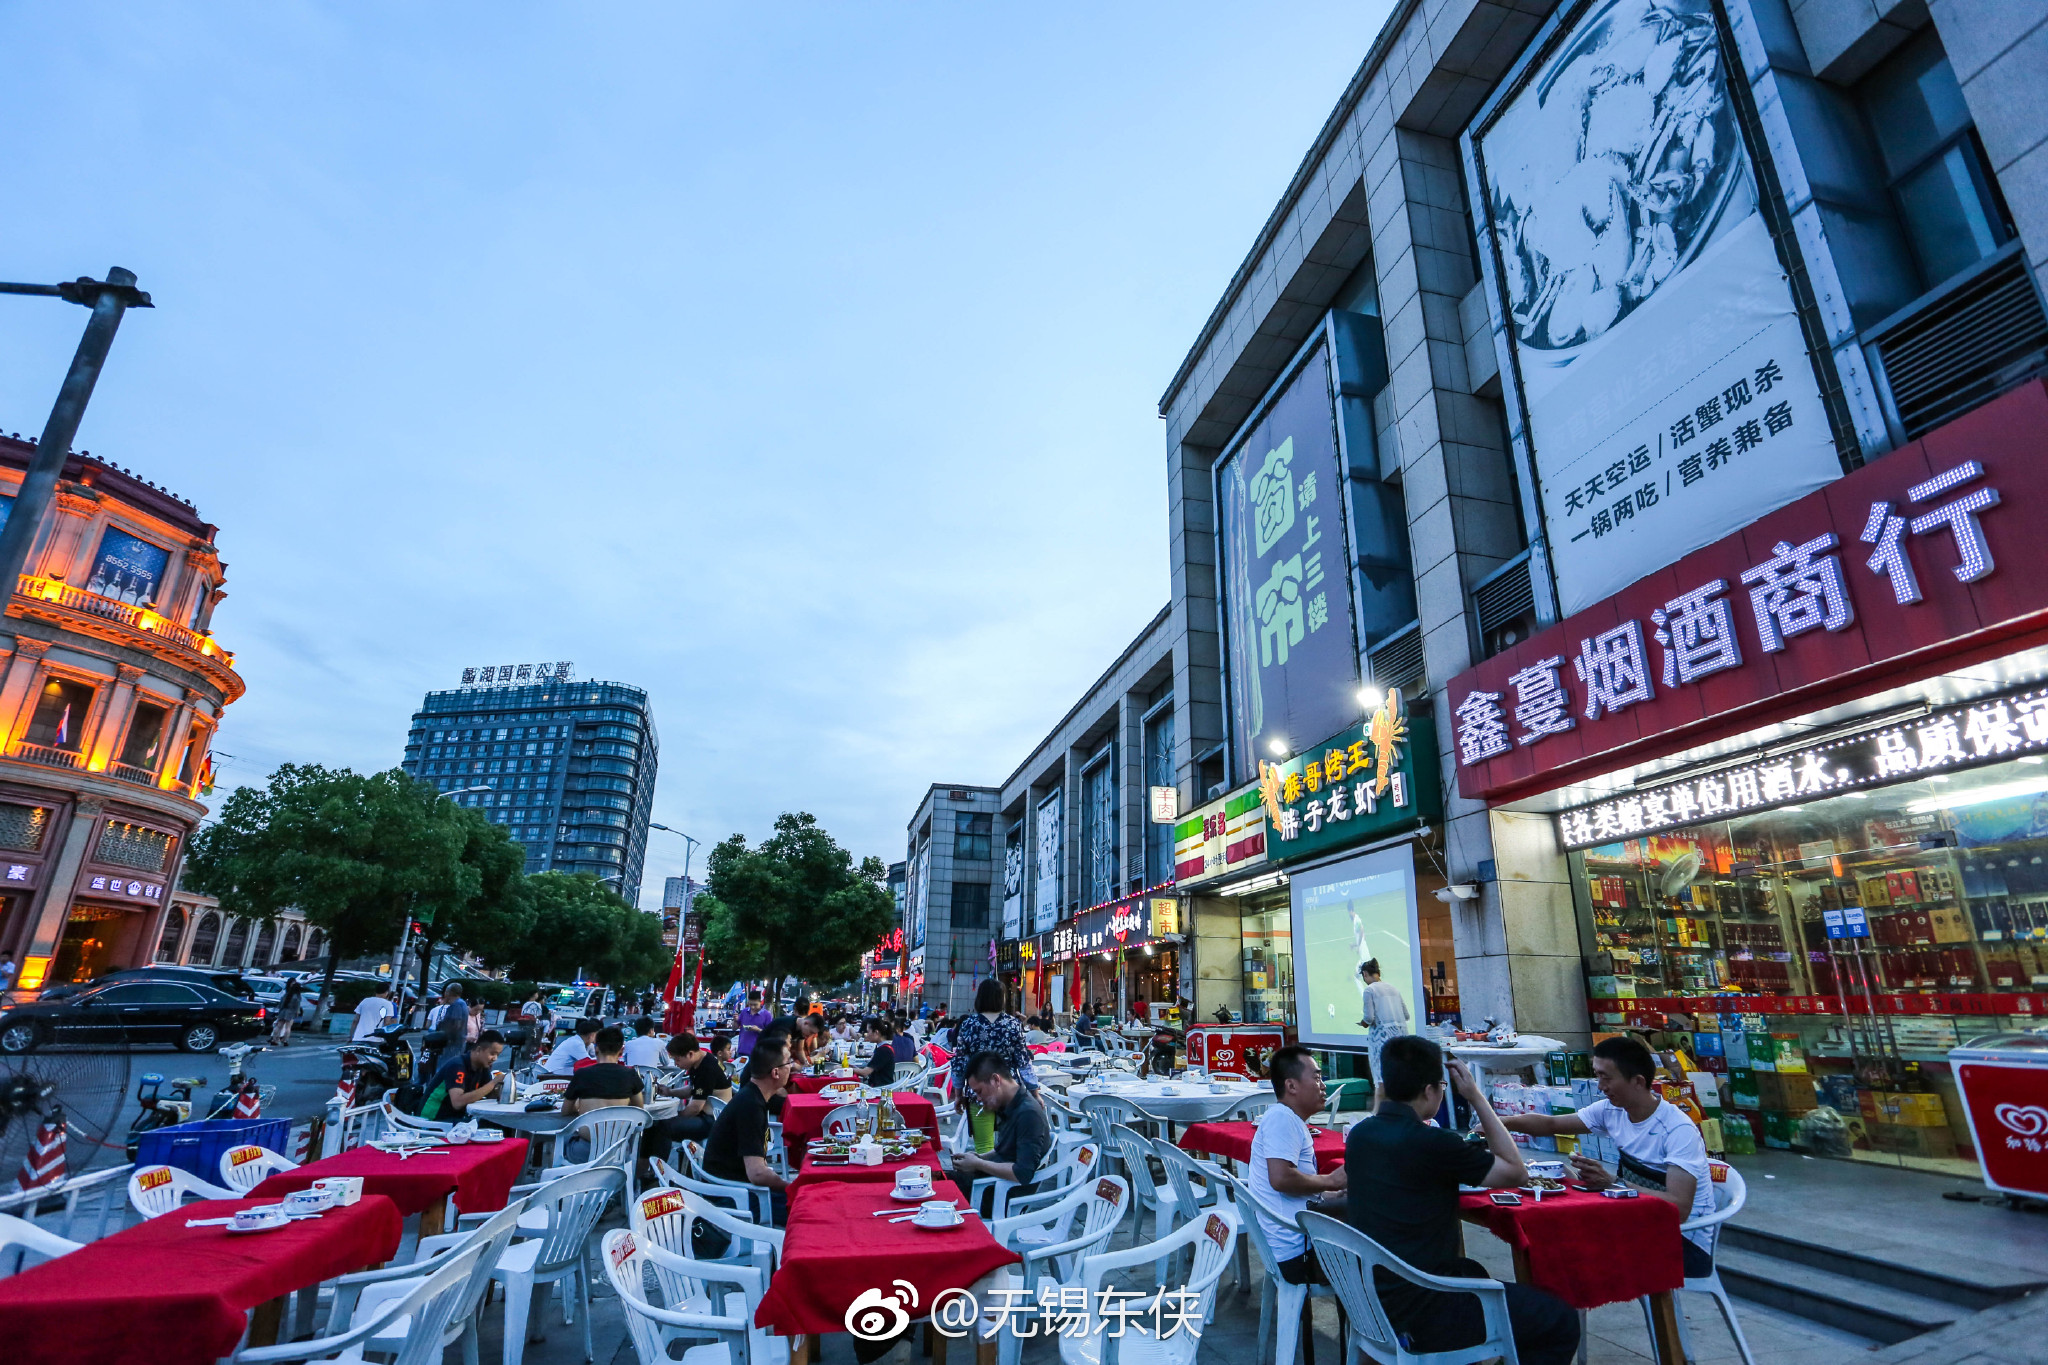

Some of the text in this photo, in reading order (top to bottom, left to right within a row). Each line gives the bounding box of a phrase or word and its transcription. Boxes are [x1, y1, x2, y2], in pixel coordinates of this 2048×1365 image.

[105, 554, 153, 580] 8552 5555
[1251, 435, 1304, 668] 窗帘
[1298, 470, 1329, 634] 请上三楼
[1455, 459, 2000, 766] 鑫蔓烟酒商行
[1283, 740, 1369, 804] 猴哥烤王
[1281, 778, 1377, 842] 胖子龙虾
[91, 876, 122, 892] 盛世
[1158, 901, 1173, 933] 超市
[455, 1071, 465, 1084] 3
